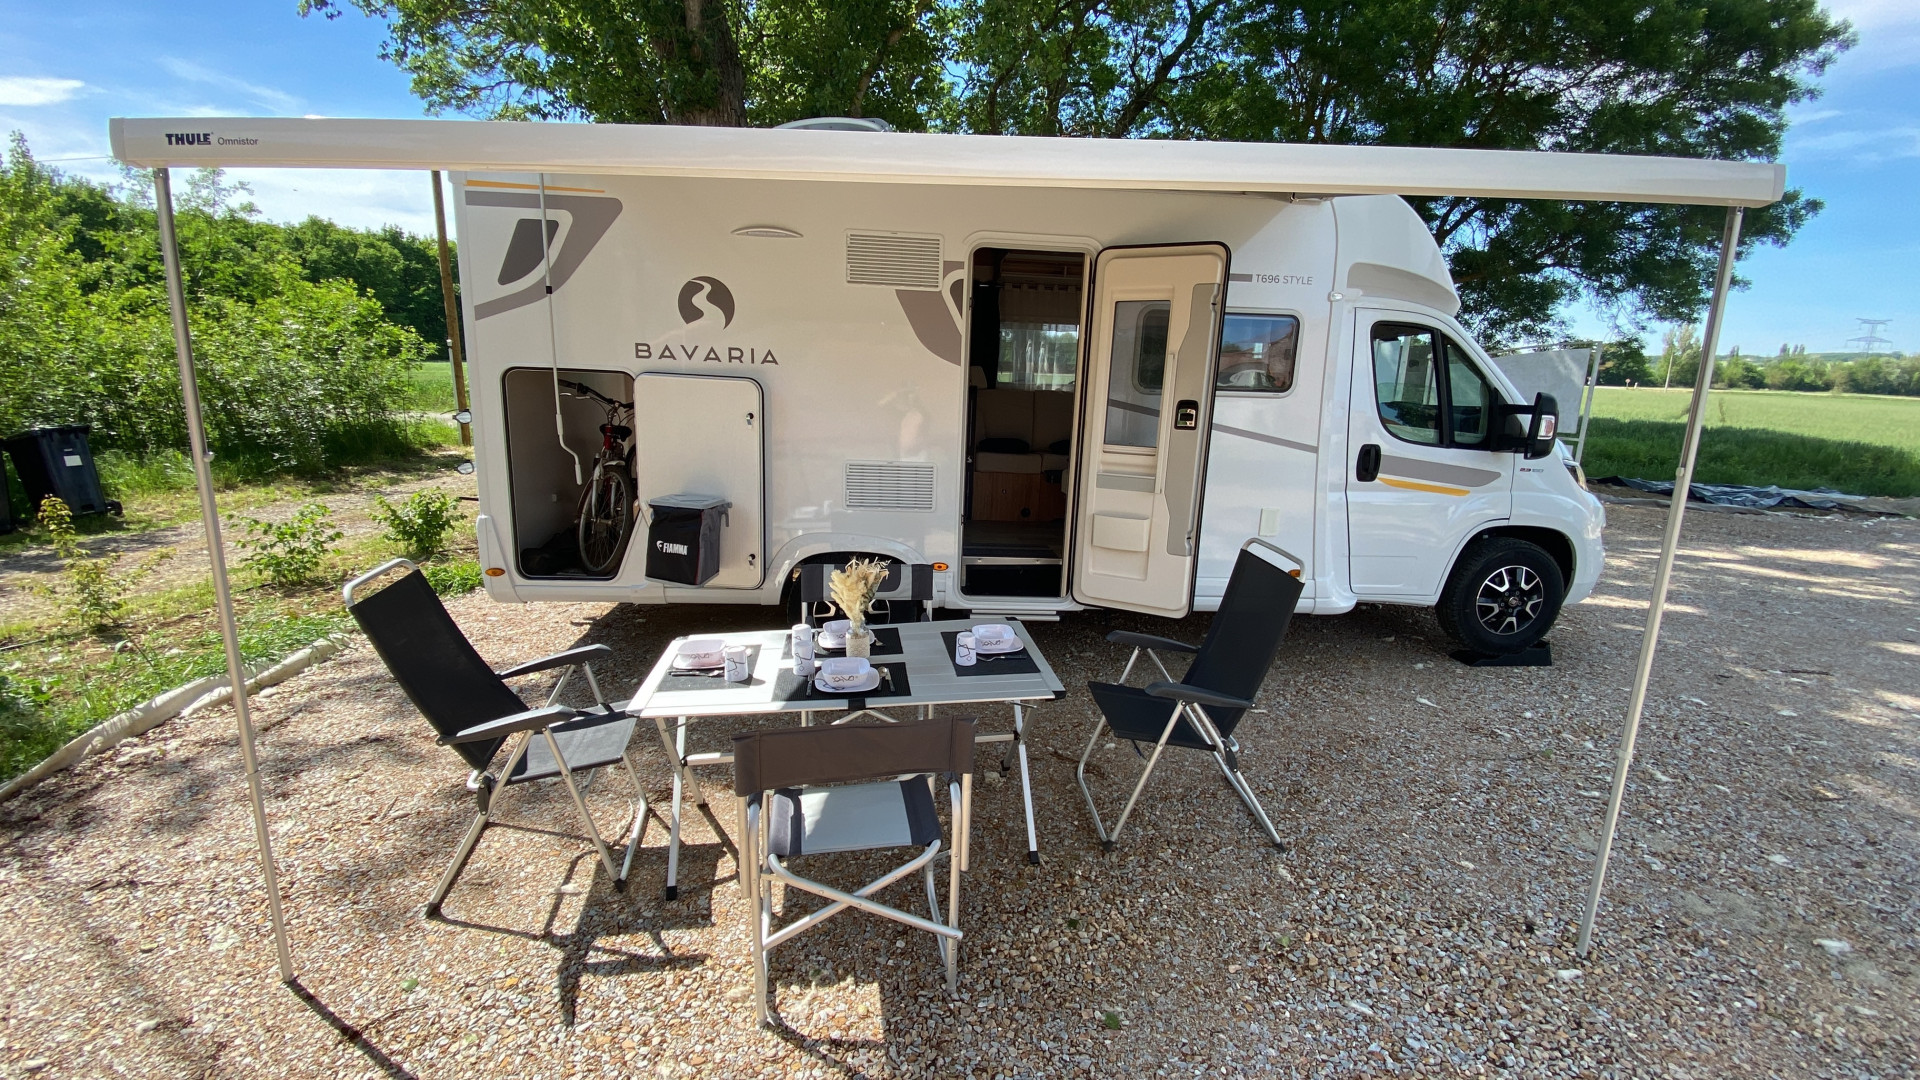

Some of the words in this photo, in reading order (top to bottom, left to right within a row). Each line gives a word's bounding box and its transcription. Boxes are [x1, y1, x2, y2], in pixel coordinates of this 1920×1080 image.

[164, 132, 212, 146] THULE
[217, 136, 259, 146] Omnistor
[1255, 273, 1280, 284] T696
[1282, 275, 1314, 286] STYLE
[634, 342, 779, 366] BAVARIA
[662, 542, 689, 556] FIAMMA
